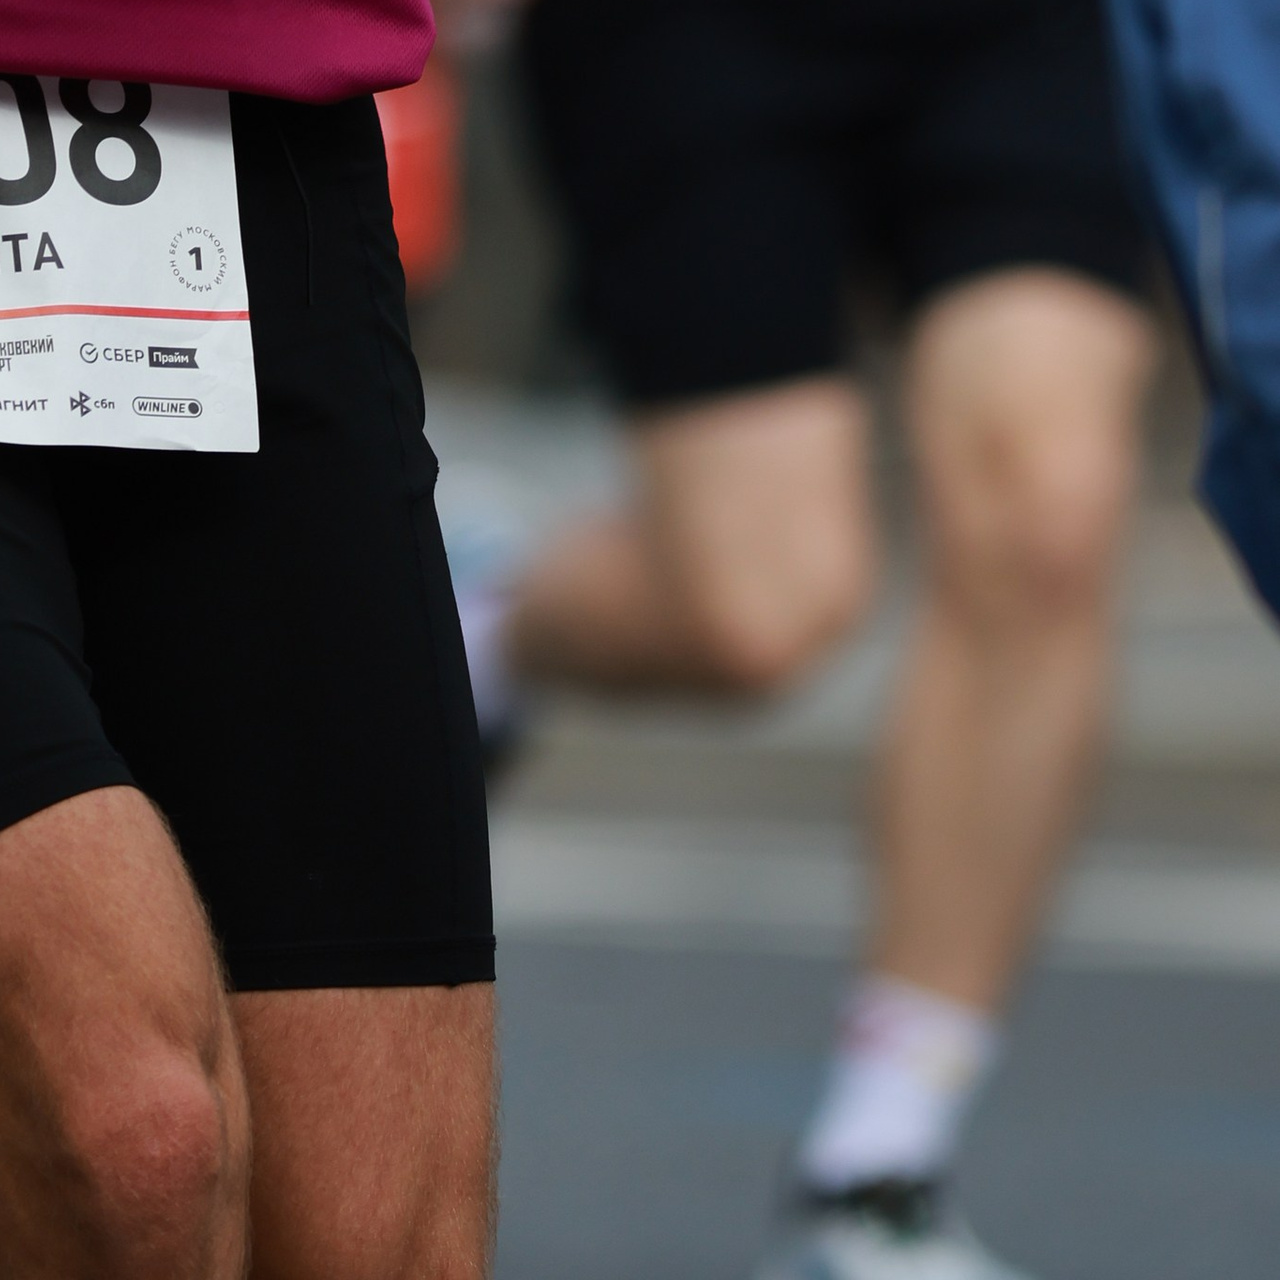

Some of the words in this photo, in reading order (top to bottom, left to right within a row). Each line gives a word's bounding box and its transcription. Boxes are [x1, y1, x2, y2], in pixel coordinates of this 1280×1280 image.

[188, 246, 202, 271] 1
[169, 260, 212, 292] МАРАФОН
[103, 347, 144, 363] СБЕР
[152, 351, 189, 365] Прайм
[94, 398, 116, 410] сбп
[138, 400, 186, 414] WINLINE
